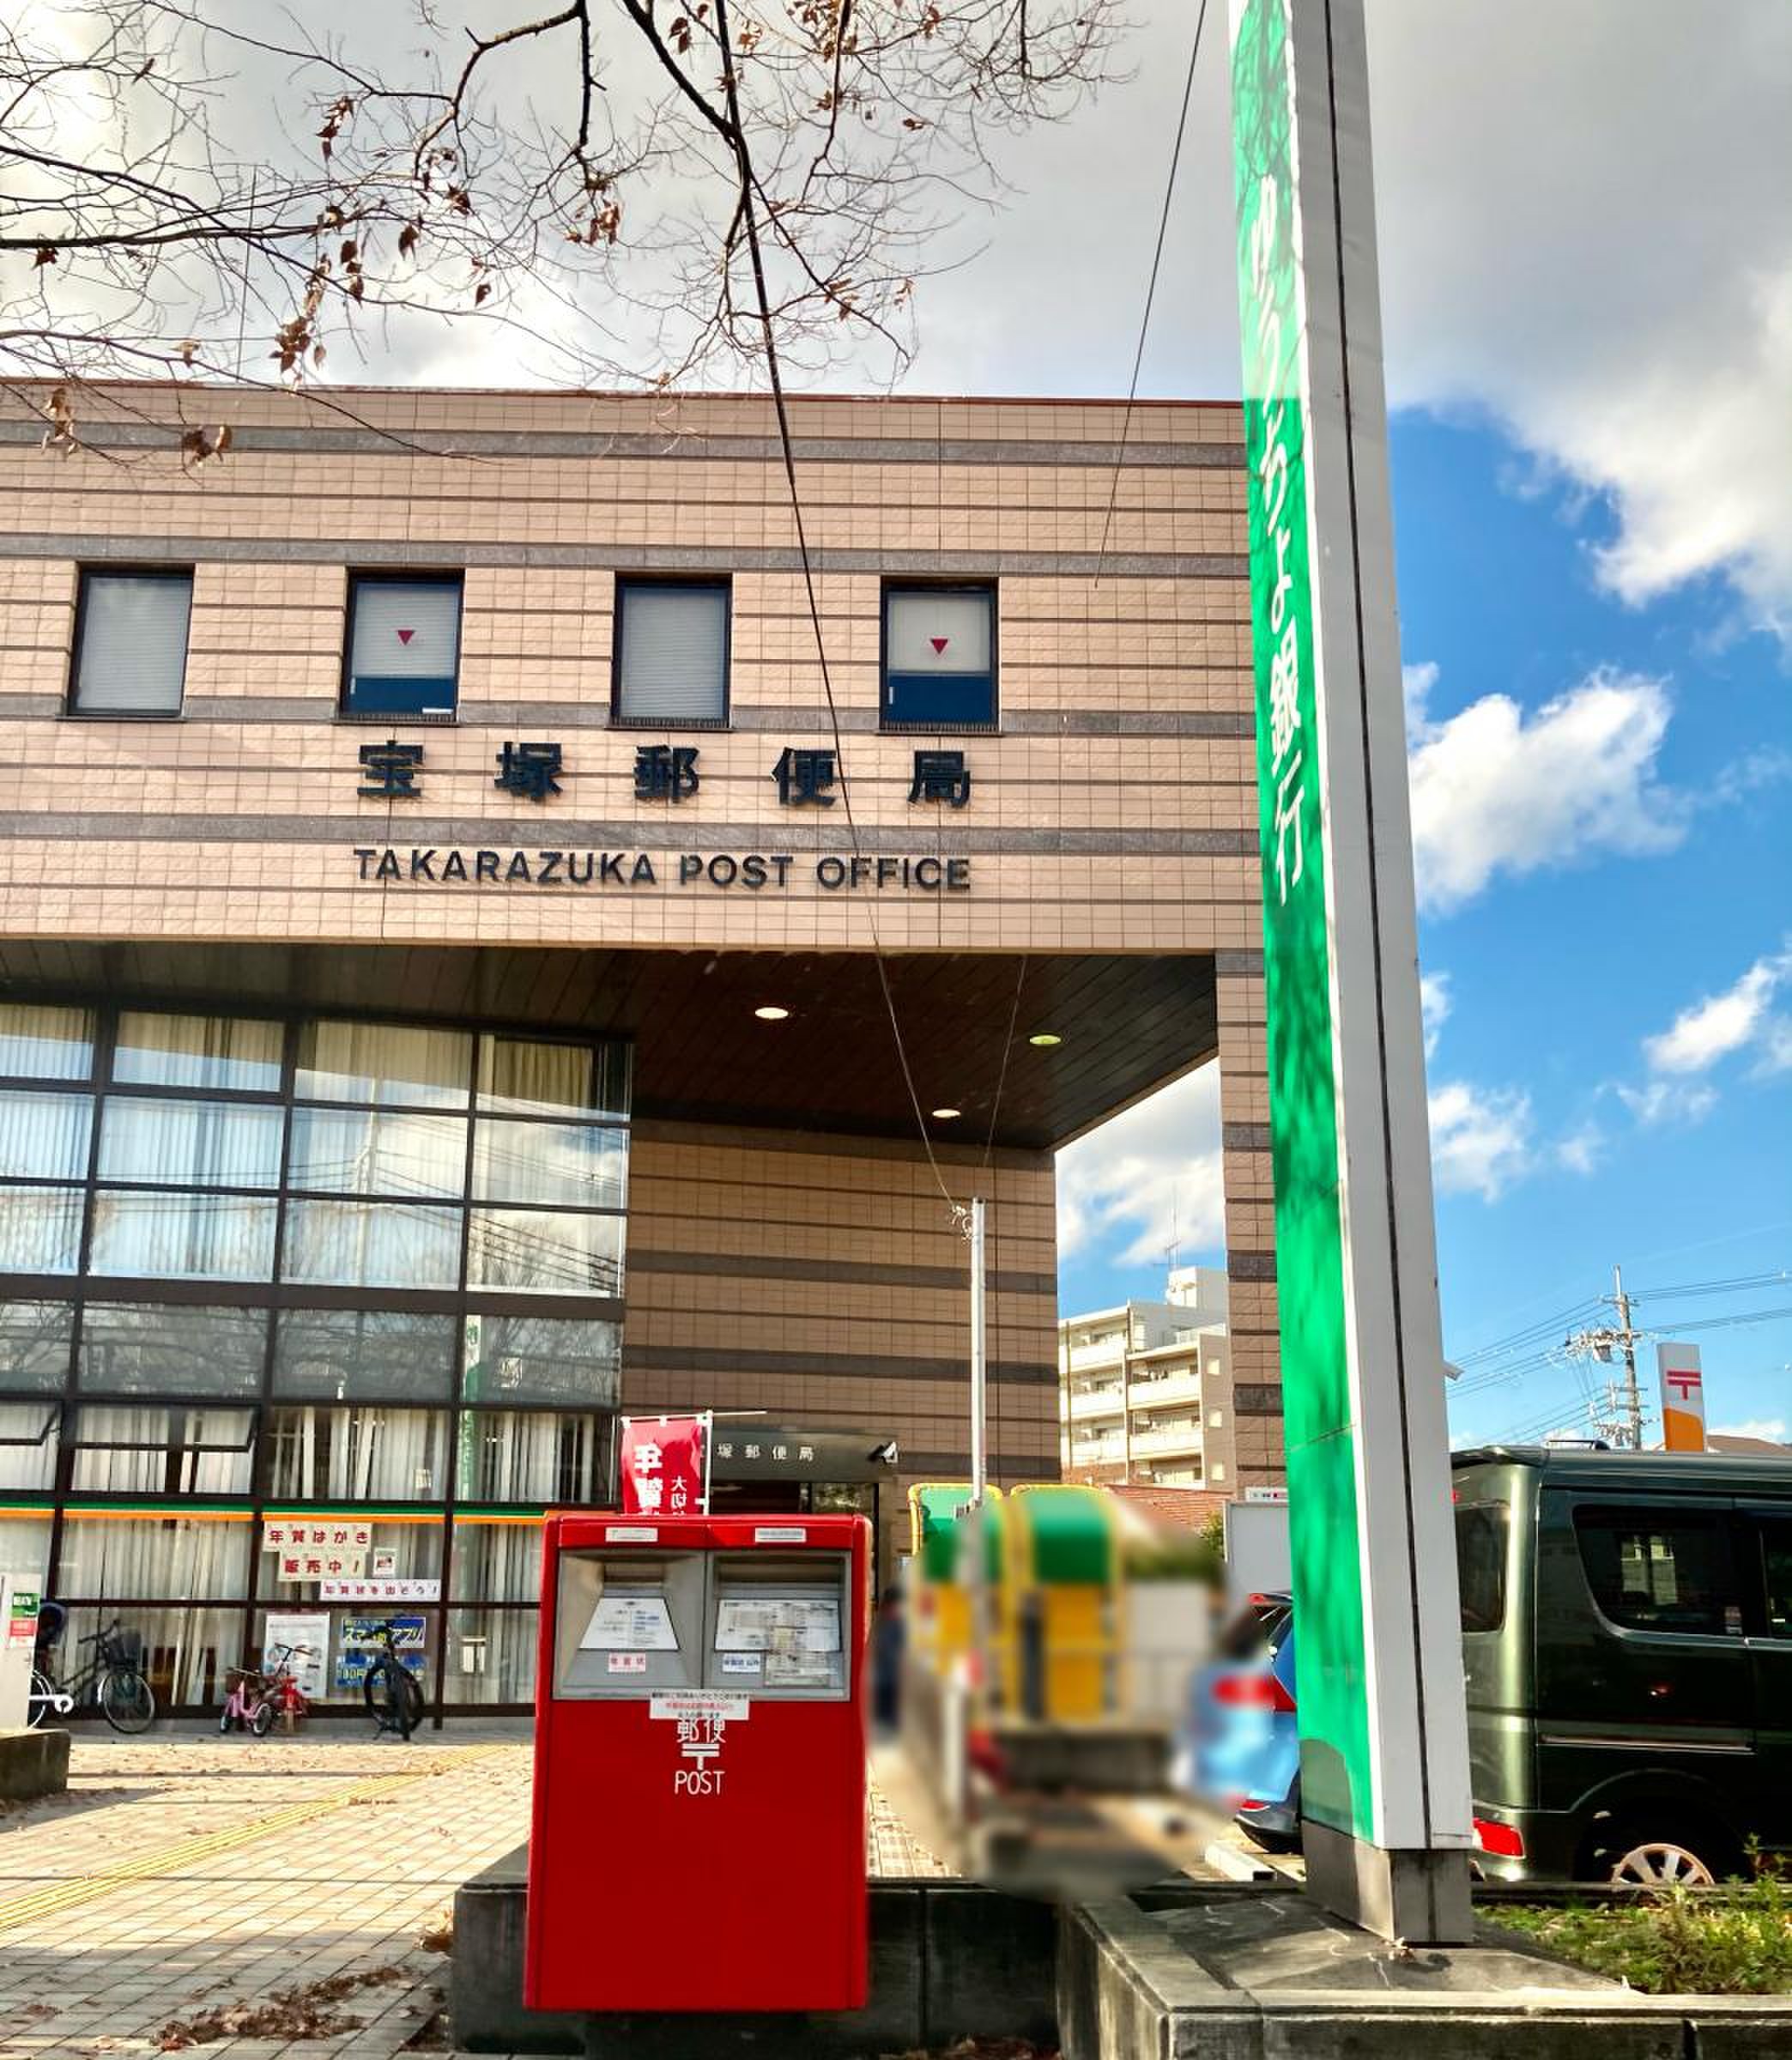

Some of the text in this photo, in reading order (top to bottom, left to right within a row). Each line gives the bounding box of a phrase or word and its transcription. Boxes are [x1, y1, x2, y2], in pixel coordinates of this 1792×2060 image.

[1251, 173, 1305, 906] ゆうちょ銀行
[357, 740, 971, 807] 宝塚郵便局
[354, 849, 971, 890] TAKARAZUKA POST OFFICE
[700, 1442, 814, 1462] 塚郵便局
[269, 1530, 369, 1544] 年賀はがき
[676, 1716, 726, 1743] 郵便
[674, 1771, 725, 1795] POST
